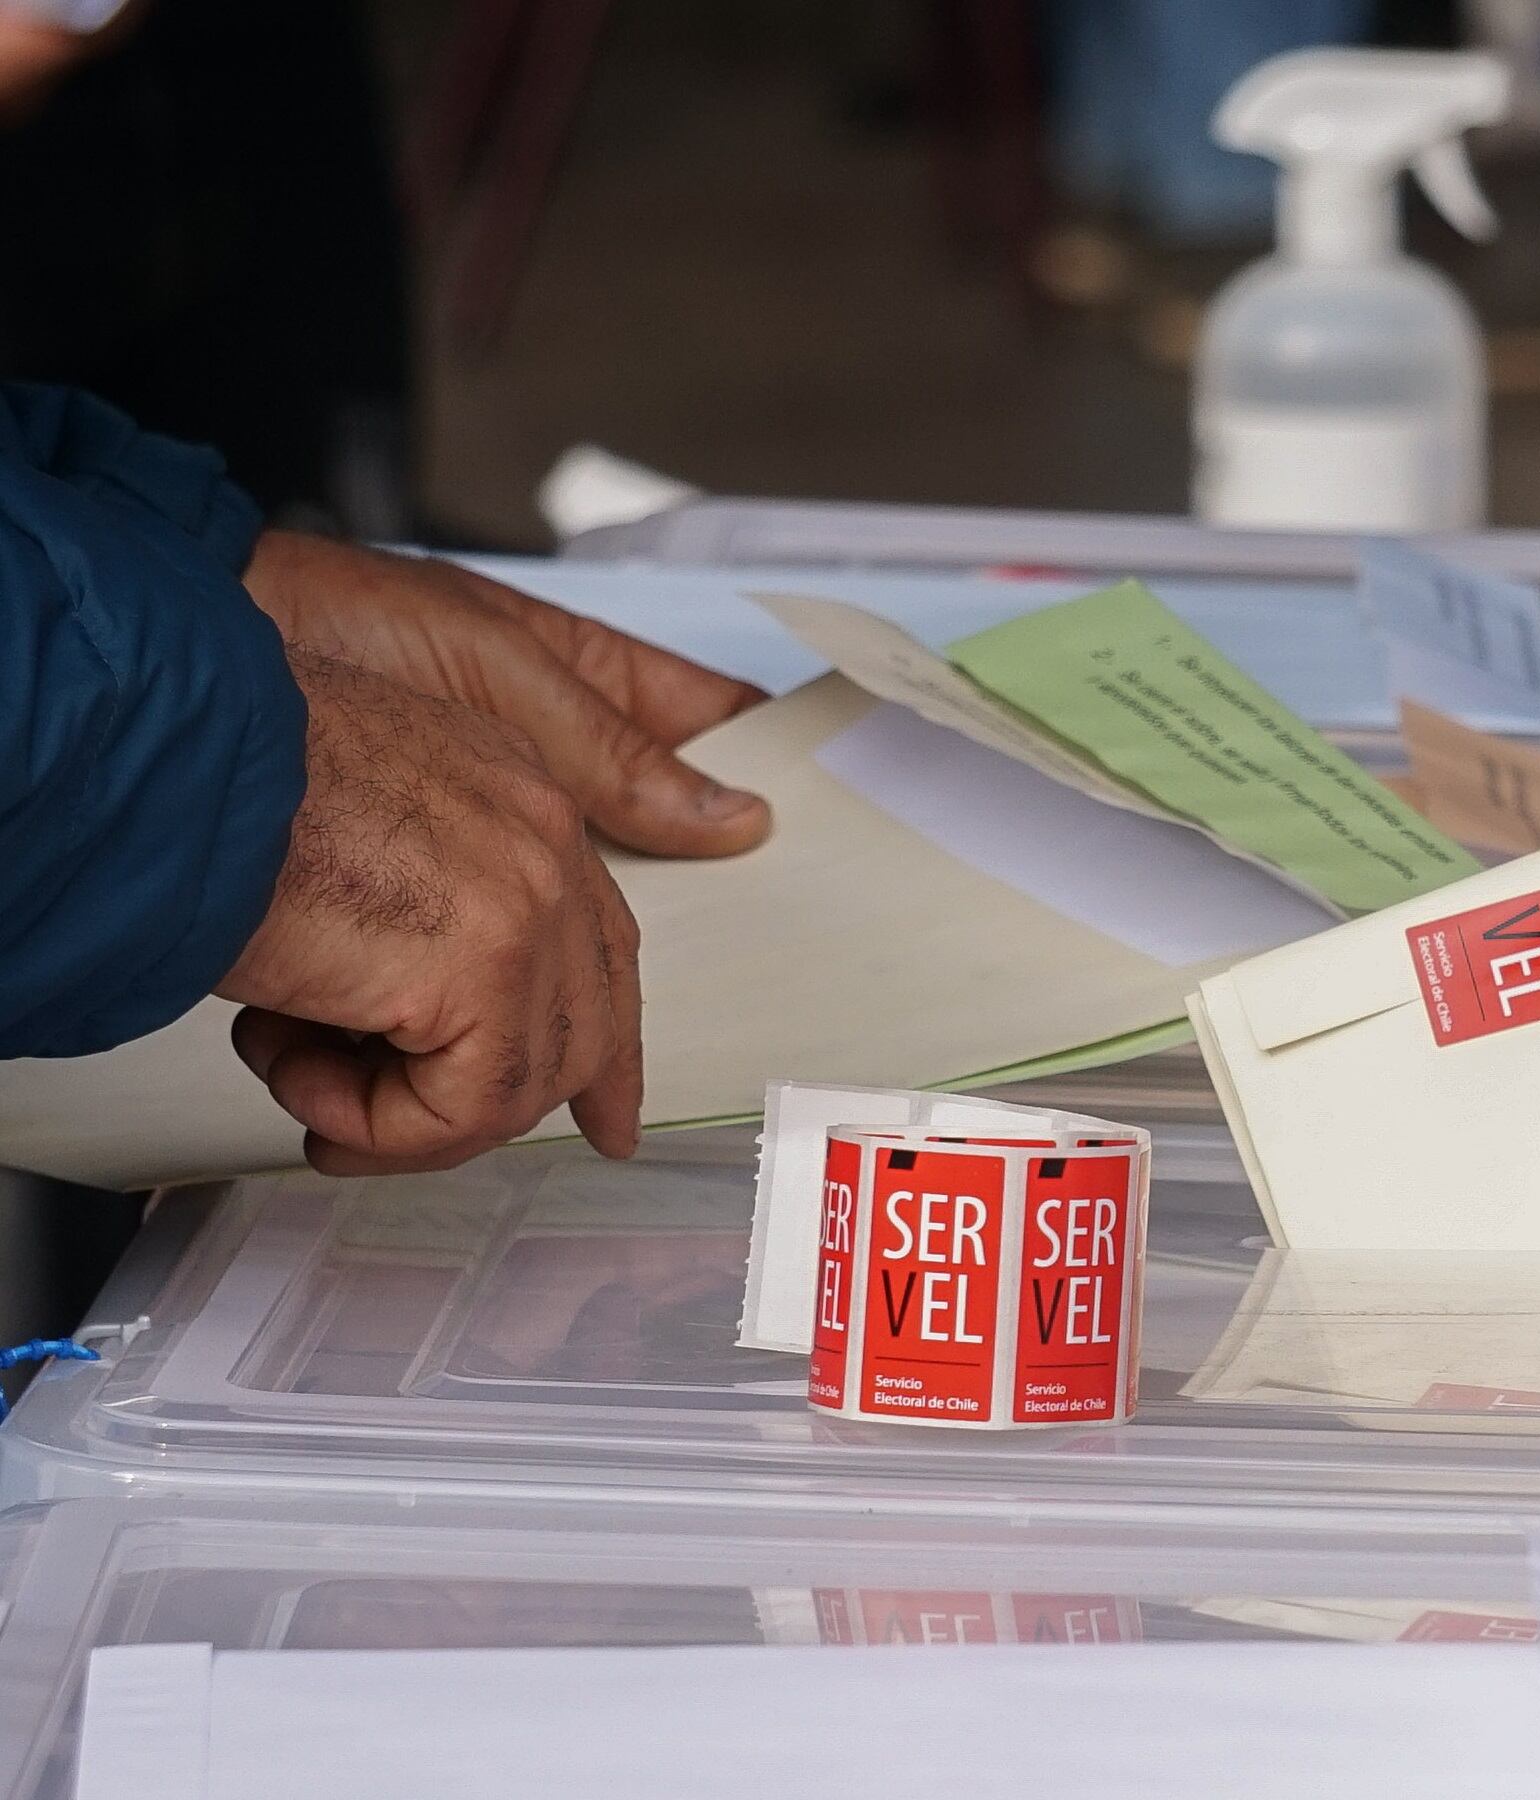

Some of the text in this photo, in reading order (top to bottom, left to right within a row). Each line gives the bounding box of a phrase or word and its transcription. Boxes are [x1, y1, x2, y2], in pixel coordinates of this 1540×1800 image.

[1416, 937, 1453, 1033] Electoral de Chile
[1432, 930, 1454, 978] Servicio
[882, 1190, 988, 1267] SER
[1032, 1198, 1118, 1268] SER
[821, 1259, 845, 1331] EL
[881, 1268, 984, 1345] VEL
[1032, 1276, 1111, 1345] VEL
[873, 1391, 980, 1412] Electoral de Chile
[874, 1374, 923, 1390] Servicio
[1024, 1398, 1107, 1412] Electoral de Chile
[1025, 1382, 1067, 1395] Servicio
